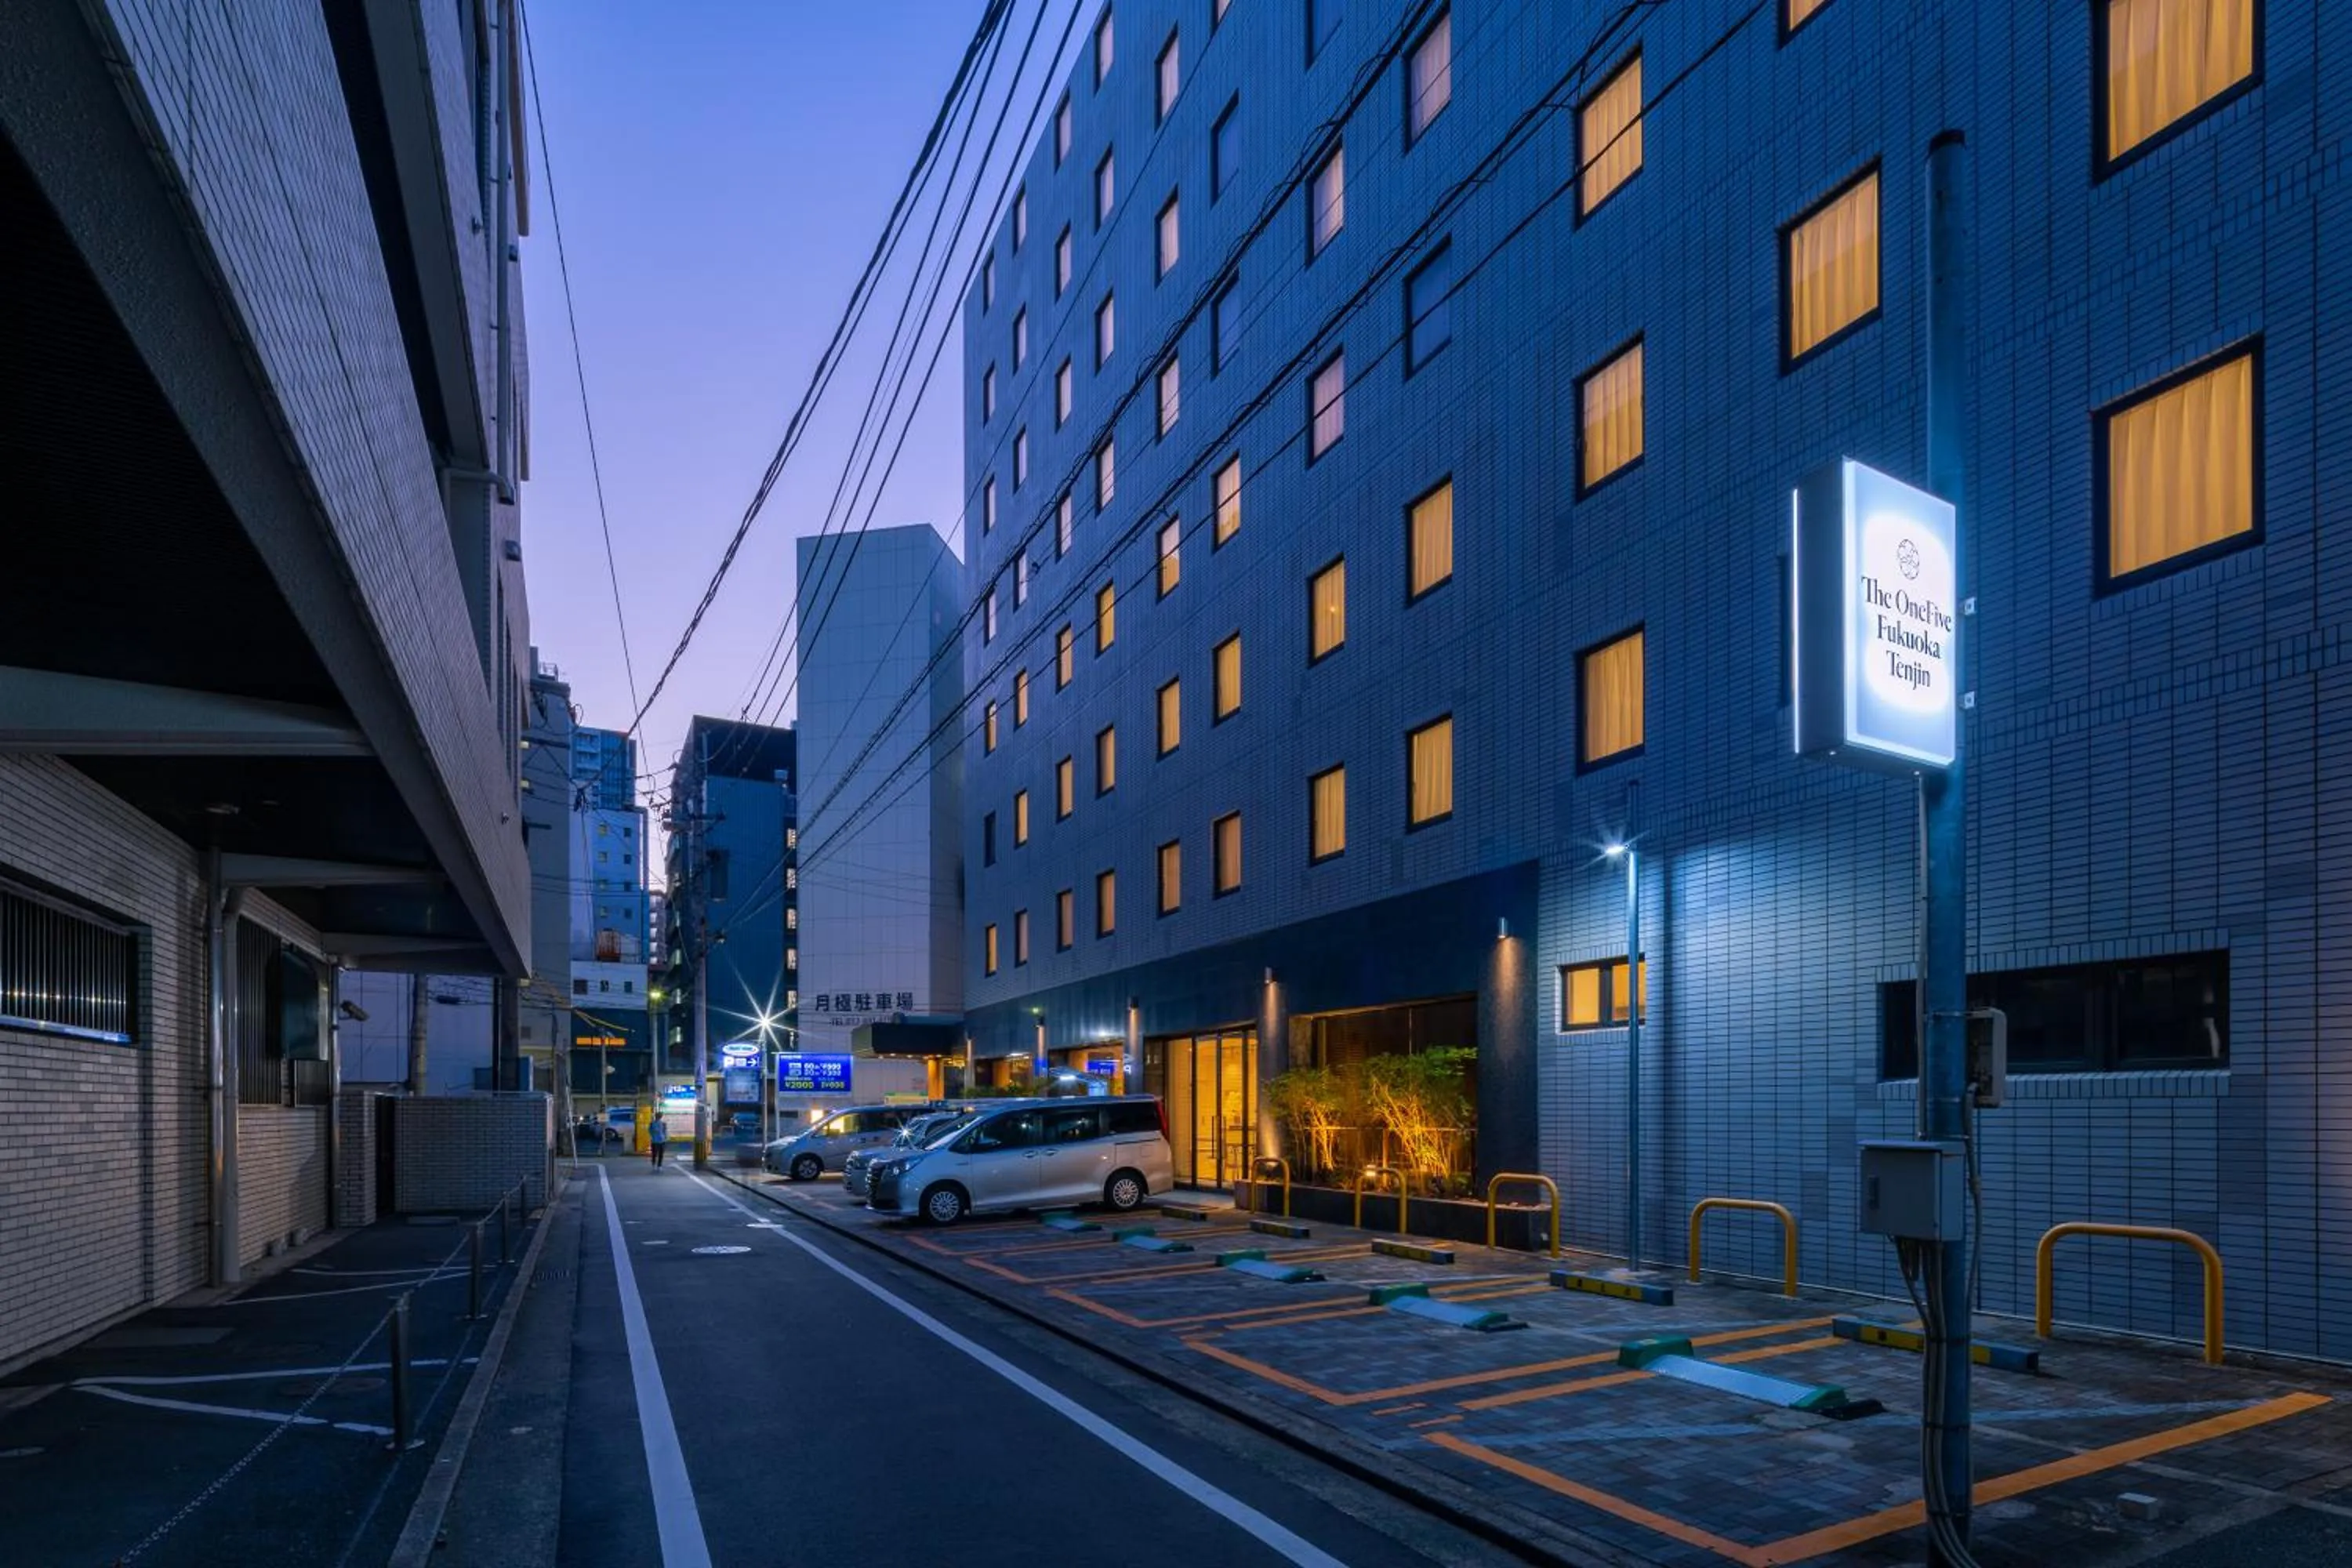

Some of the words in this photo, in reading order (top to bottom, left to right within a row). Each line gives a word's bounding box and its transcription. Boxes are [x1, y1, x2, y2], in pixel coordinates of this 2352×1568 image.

[1861, 575, 1892, 608] The
[1896, 590, 1951, 632] OneFive
[1878, 615, 1941, 659] Fukuoka
[1886, 650, 1930, 690] Tenjin
[815, 992, 913, 1011] 月極駐車場
